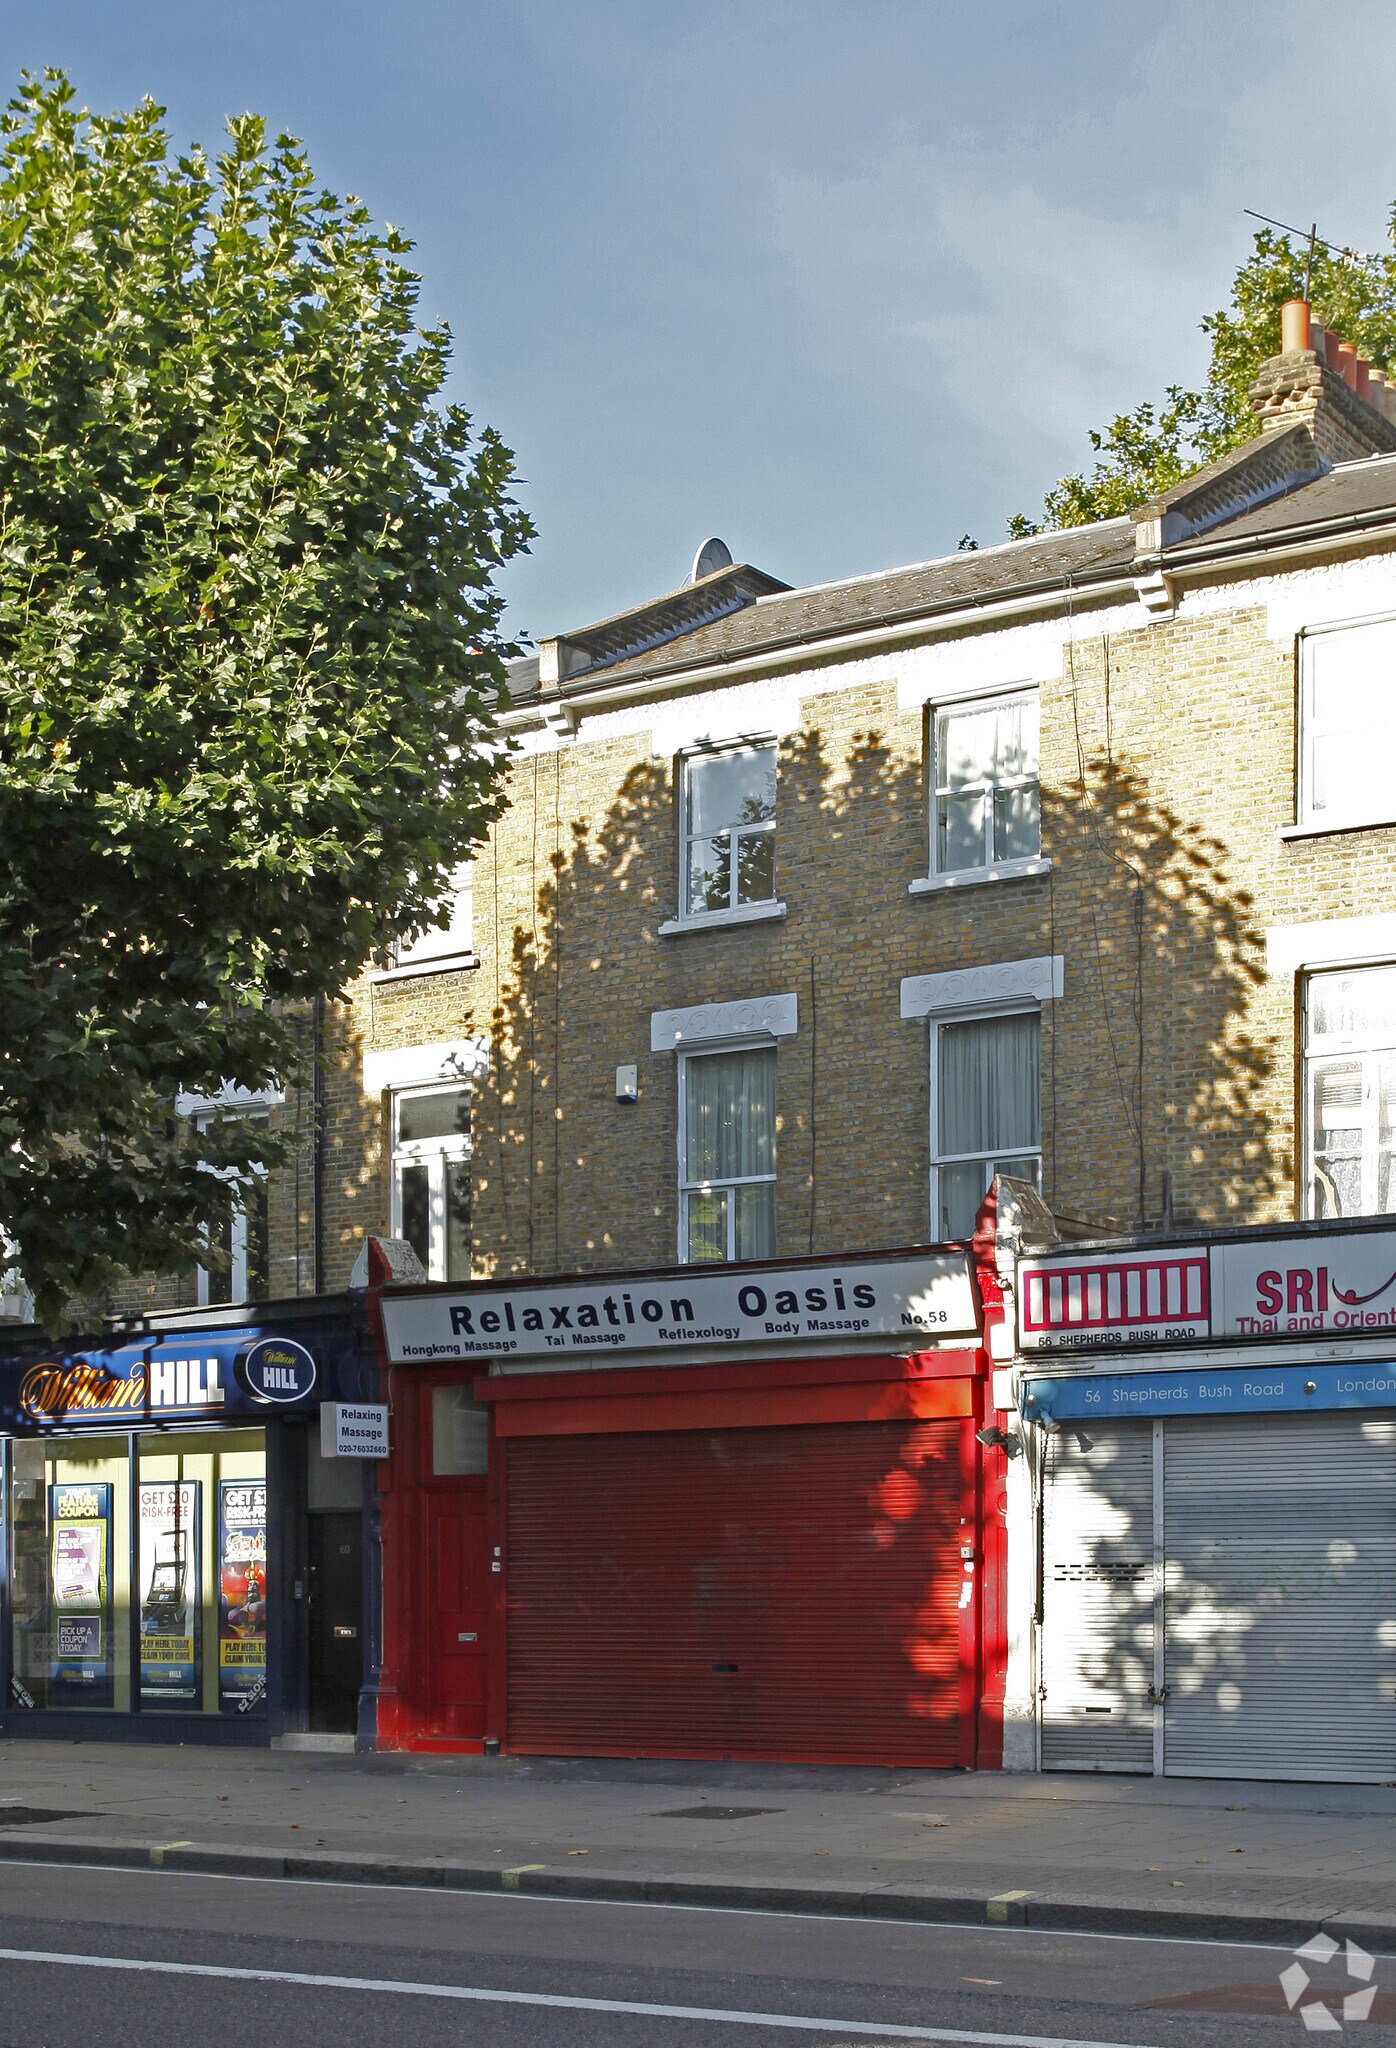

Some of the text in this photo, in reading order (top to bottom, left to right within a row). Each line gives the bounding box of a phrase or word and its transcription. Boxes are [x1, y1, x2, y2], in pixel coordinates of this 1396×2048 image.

[1256, 1266, 1328, 1315] SRI
[449, 1278, 876, 1336] Relaxation Oasis
[901, 1310, 948, 1325] No.58
[1236, 1316, 1278, 1333] Thai
[1287, 1312, 1324, 1331] and
[402, 1318, 870, 1357] Hongkong Massage Tai Massage Reflexology Body Massage
[1038, 1327, 1196, 1347] 56 SHEPHERDS BUSH ROAD
[263, 1349, 297, 1365] William
[263, 1366, 298, 1390] HILL
[19, 1358, 225, 1417] William HILL
[1084, 1377, 1396, 1403] 56 Shepherds Bush Road London
[341, 1409, 382, 1423] Relaxing
[341, 1427, 383, 1439] Massage
[338, 1444, 387, 1454] 020-76032660
[142, 1490, 189, 1505] GET £0
[226, 1490, 253, 1506] GET
[58, 1506, 99, 1518] COUPON
[60, 1627, 92, 1635] PICK UP A
[60, 1635, 88, 1644] COUPON
